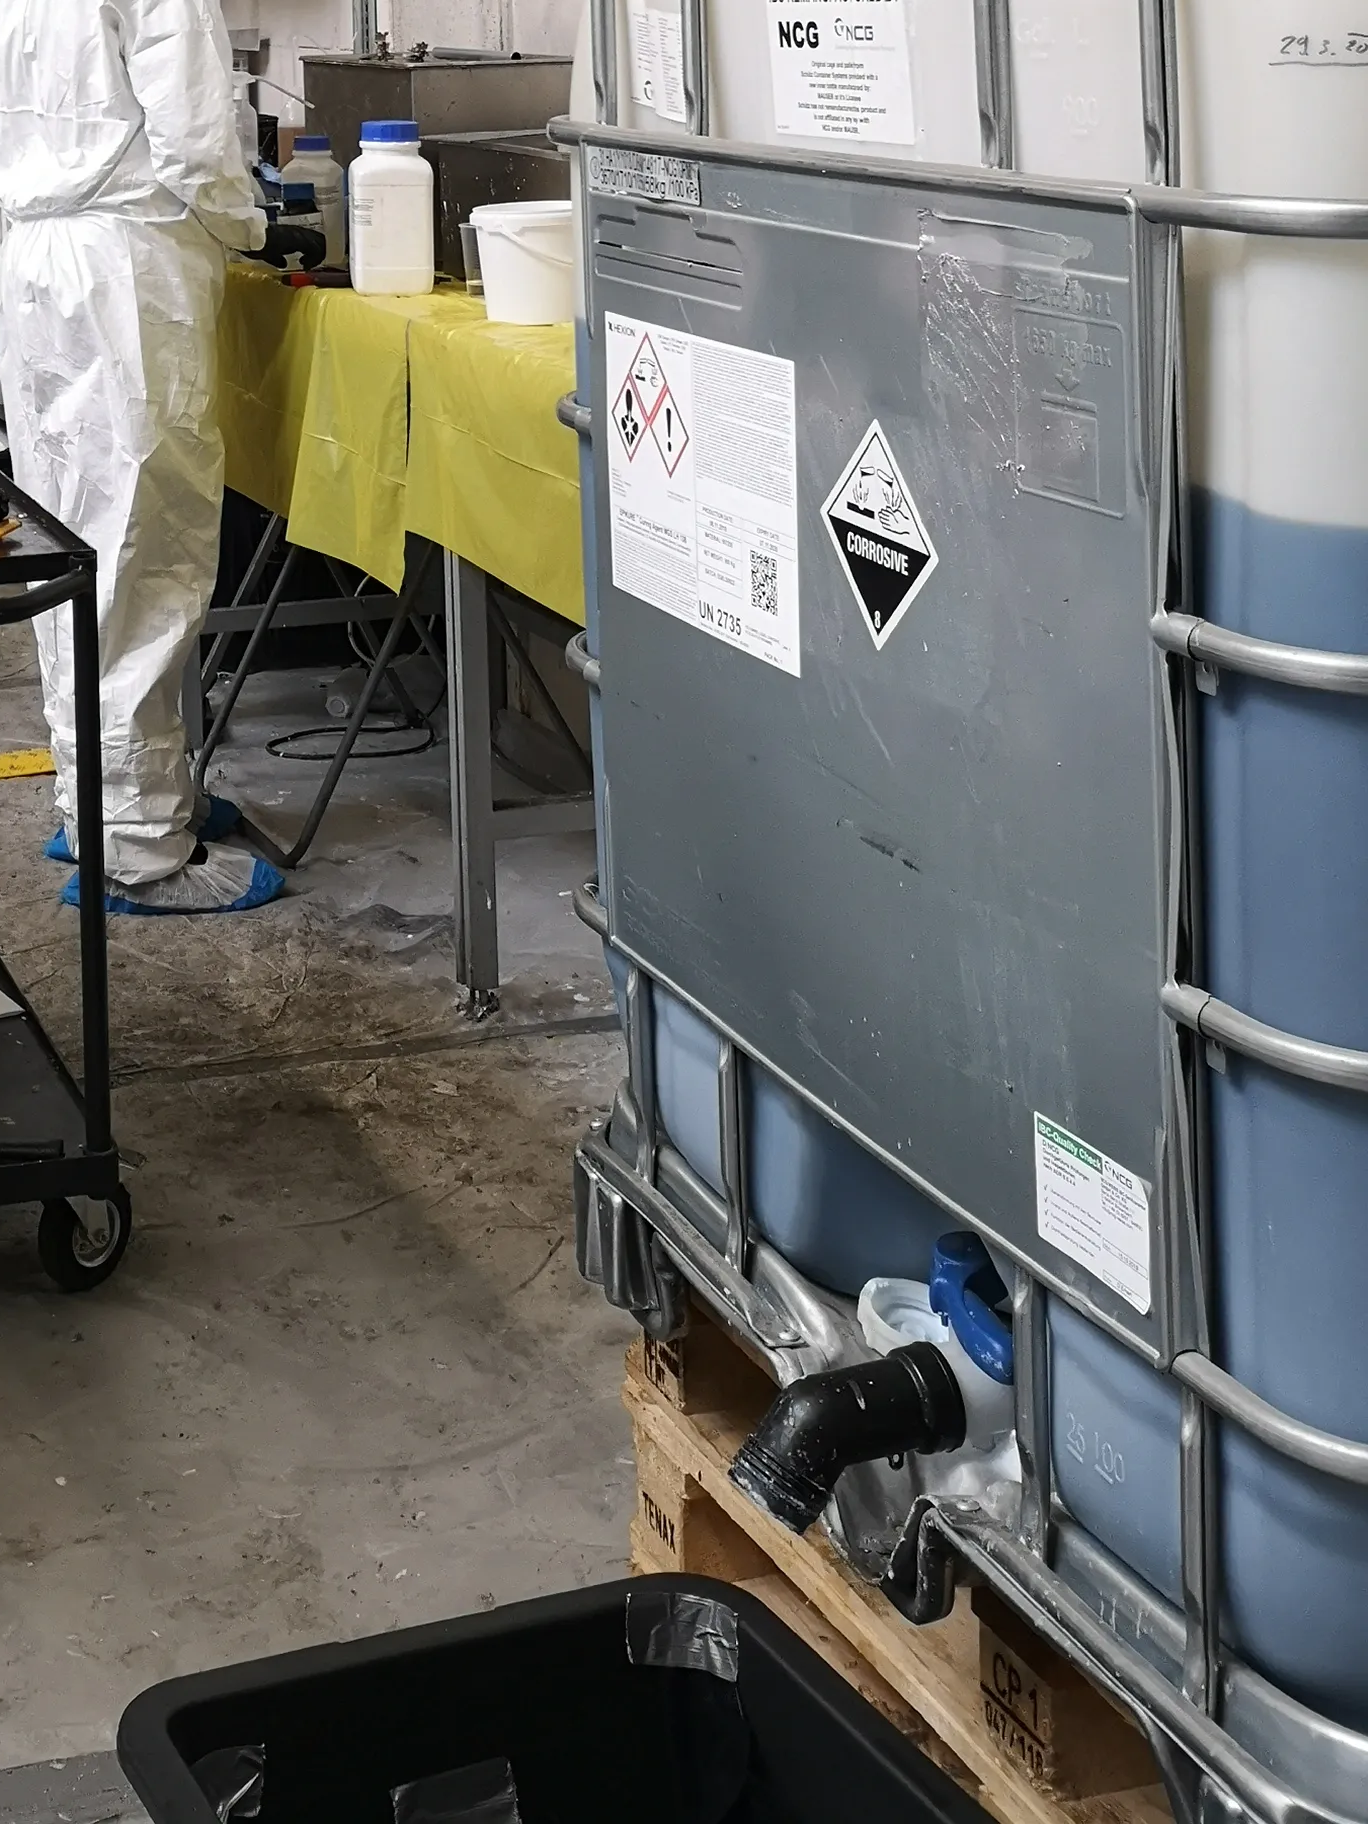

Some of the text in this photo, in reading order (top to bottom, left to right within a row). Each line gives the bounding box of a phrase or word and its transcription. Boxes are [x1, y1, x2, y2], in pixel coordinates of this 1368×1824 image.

[778, 21, 819, 49] NCG
[845, 25, 874, 41] NCG
[846, 531, 909, 576] CORROSIVE
[699, 599, 742, 636] UN 2735
[874, 610, 881, 629] 8
[1038, 1121, 1102, 1171] IBC-Quality Check
[642, 1490, 676, 1554] TENAX
[993, 1652, 1021, 1705] CP
